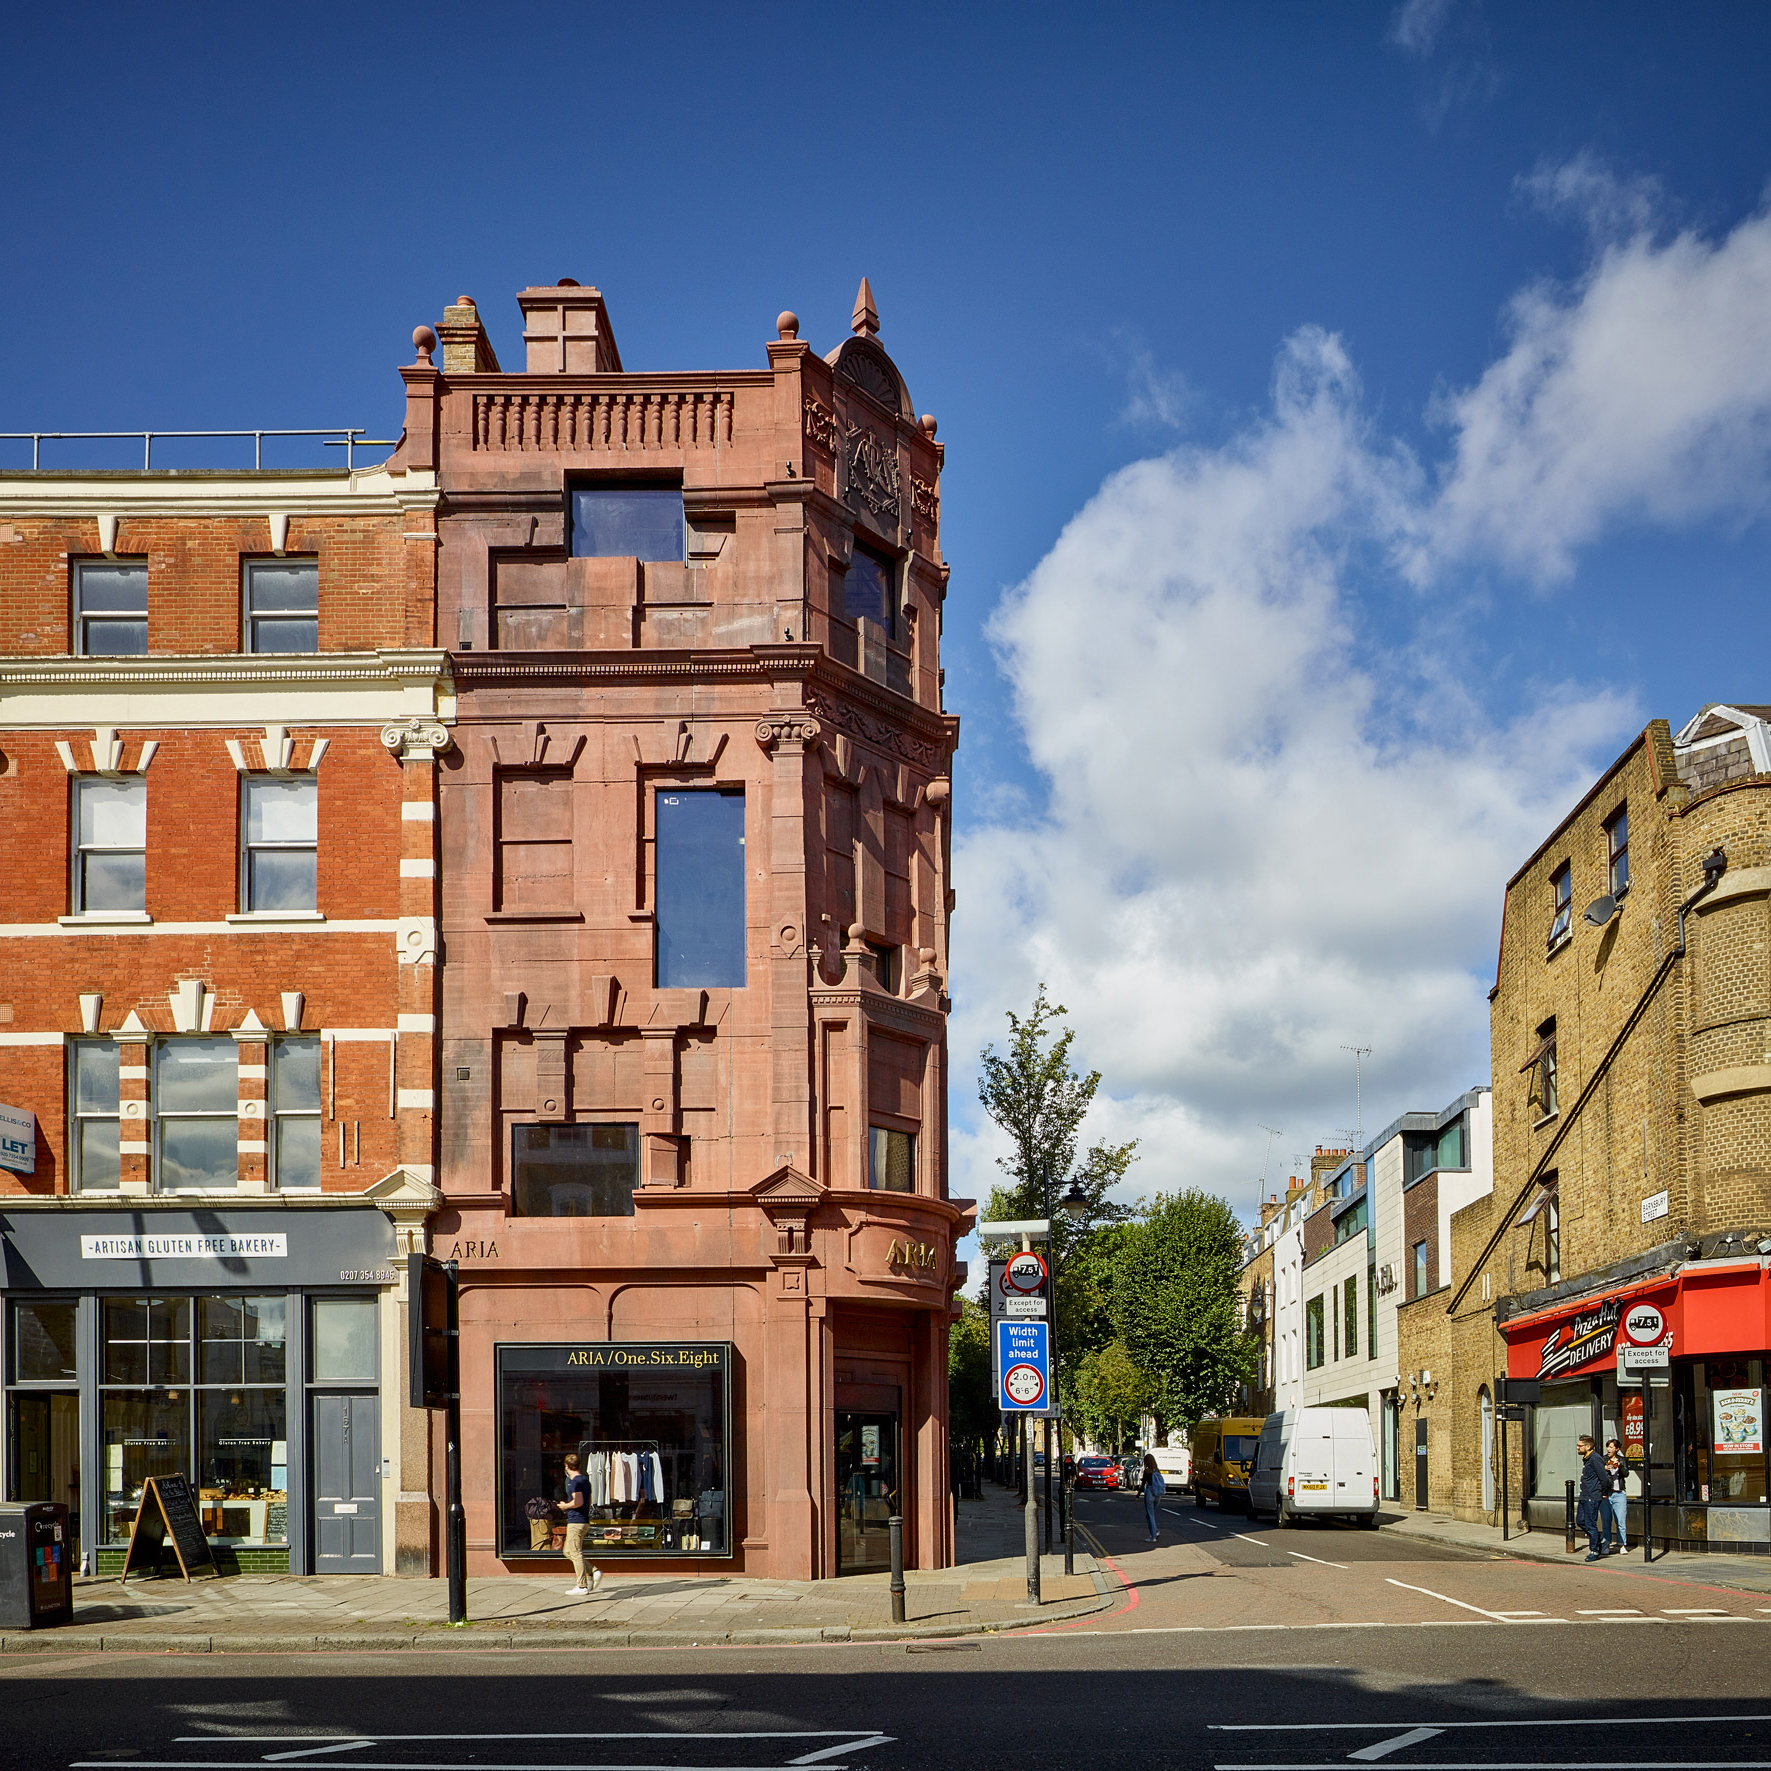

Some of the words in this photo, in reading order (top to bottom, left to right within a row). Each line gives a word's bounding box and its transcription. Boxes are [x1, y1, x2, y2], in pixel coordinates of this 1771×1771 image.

[2, 1138, 28, 1155] LET
[1643, 1196, 1666, 1212] BARNSBURY
[1643, 1208, 1657, 1221] STREET
[148, 1240, 192, 1253] GLUTEN
[198, 1239, 226, 1253] FREE
[450, 1241, 501, 1258] ARIA
[885, 1239, 938, 1269] ARIA
[340, 1270, 358, 1281] 0207
[360, 1270, 374, 1281] 354
[1573, 1316, 1599, 1341] Pizza
[1599, 1301, 1620, 1326] Hut
[1008, 1326, 1038, 1336] Width
[1012, 1337, 1035, 1347] limit
[1569, 1331, 1614, 1366] DELIVERY
[1008, 1349, 1039, 1358] ahead
